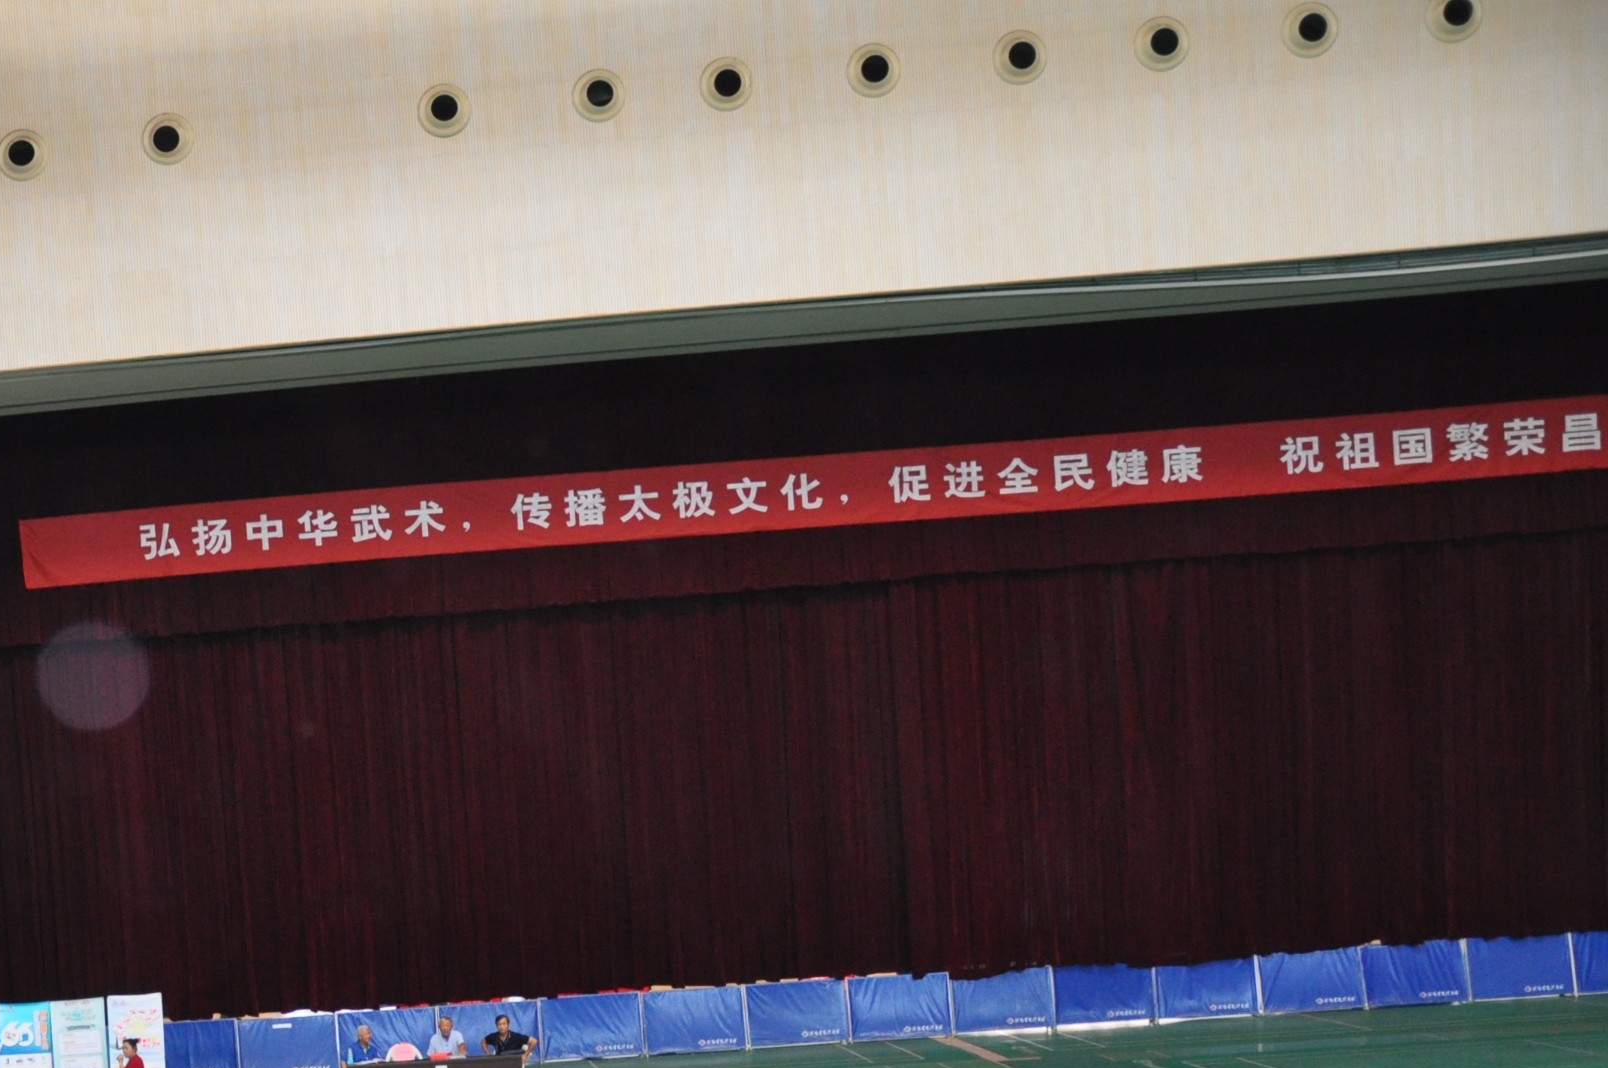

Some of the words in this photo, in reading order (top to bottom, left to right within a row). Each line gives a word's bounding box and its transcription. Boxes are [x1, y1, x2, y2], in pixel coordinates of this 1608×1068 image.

[1279, 412, 1603, 475] 祝祖国繁荣昌
